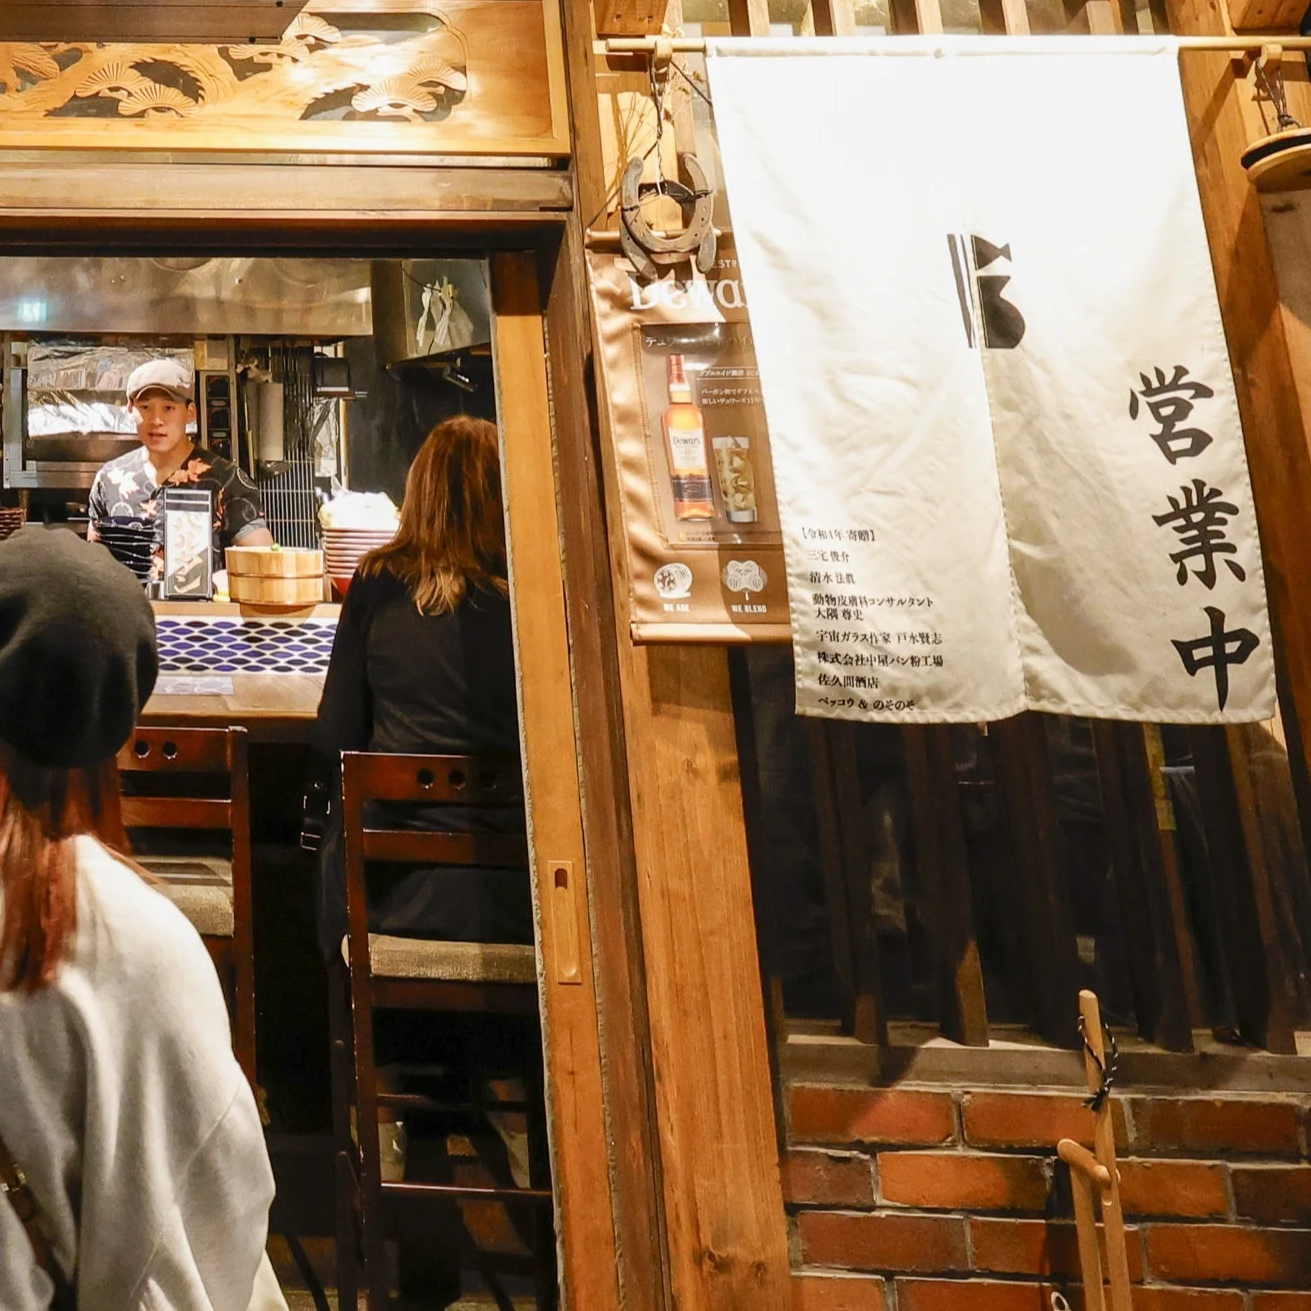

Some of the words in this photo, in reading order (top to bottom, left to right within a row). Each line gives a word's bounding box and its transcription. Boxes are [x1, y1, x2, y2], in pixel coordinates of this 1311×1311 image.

[1129, 365, 1260, 711] 営業中
[731, 604, 742, 613] WE
[815, 630, 891, 644] 宇宙ガラス作家
[817, 650, 944, 668] 株式会社中屋パン粉工場
[818, 673, 879, 689] 佐久間酒店
[858, 699, 868, 710] &
[873, 699, 916, 711] のそのそ
